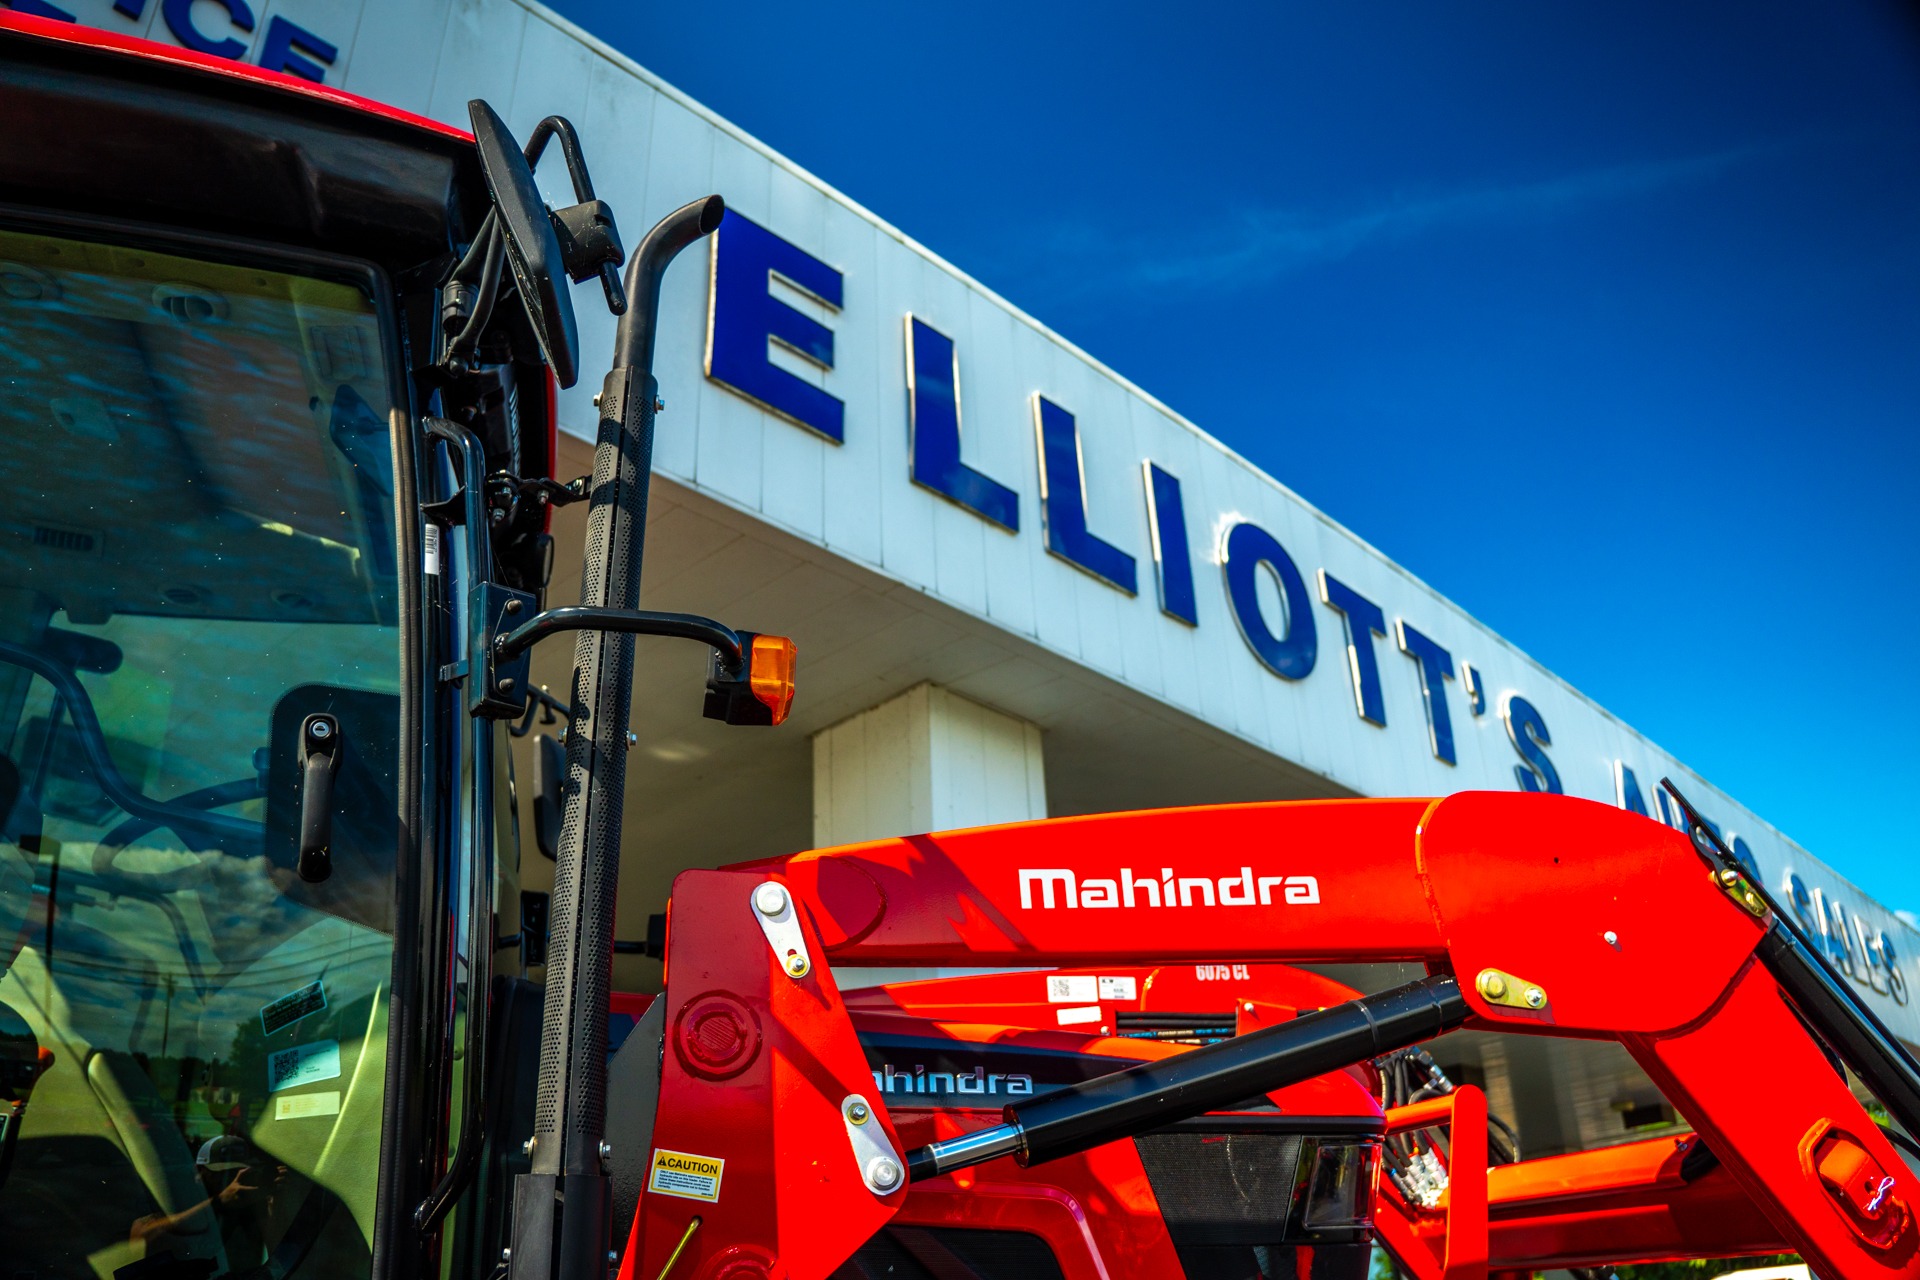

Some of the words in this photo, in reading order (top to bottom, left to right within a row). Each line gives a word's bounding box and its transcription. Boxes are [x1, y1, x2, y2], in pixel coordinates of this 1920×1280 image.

[703, 205, 1564, 793] ELLIOTT'S
[1018, 867, 1321, 909] Mahindra
[1195, 964, 1231, 982] 6075
[1232, 964, 1251, 981] CL
[872, 1064, 1034, 1095] hindra
[667, 1158, 718, 1175] CAUTION
